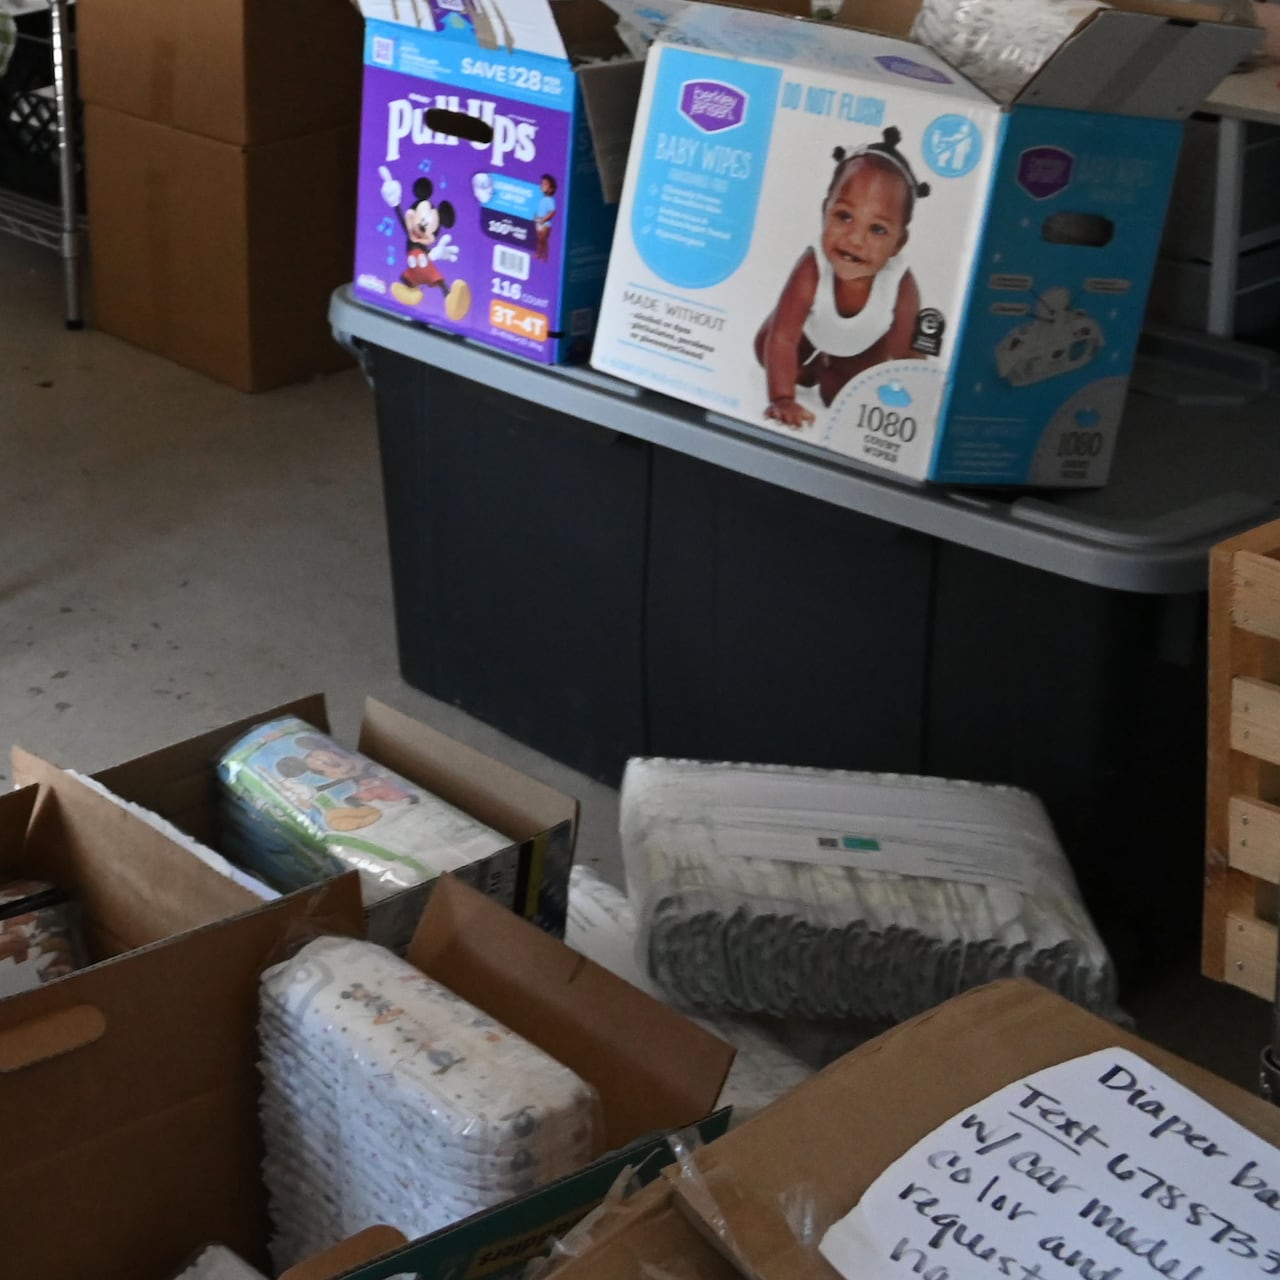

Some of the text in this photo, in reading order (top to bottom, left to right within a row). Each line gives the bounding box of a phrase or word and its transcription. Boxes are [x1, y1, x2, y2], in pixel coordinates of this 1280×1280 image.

[461, 57, 507, 84] SAVE
[507, 64, 544, 92] $28
[804, 85, 837, 117] NOT
[654, 132, 700, 167] BABY
[701, 138, 753, 180] WIPES
[491, 277, 523, 301] 116
[622, 290, 727, 332] MADE WITHOUT
[857, 403, 916, 443] 1080
[863, 434, 902, 454] COUNT
[861, 445, 899, 464] WIPES
[1018, 1082, 1111, 1150] Text
[1097, 1063, 1231, 1160] Diaper
[1007, 1150, 1086, 1197] car
[897, 1180, 1046, 1280] request
[1037, 1234, 1127, 1280] and
